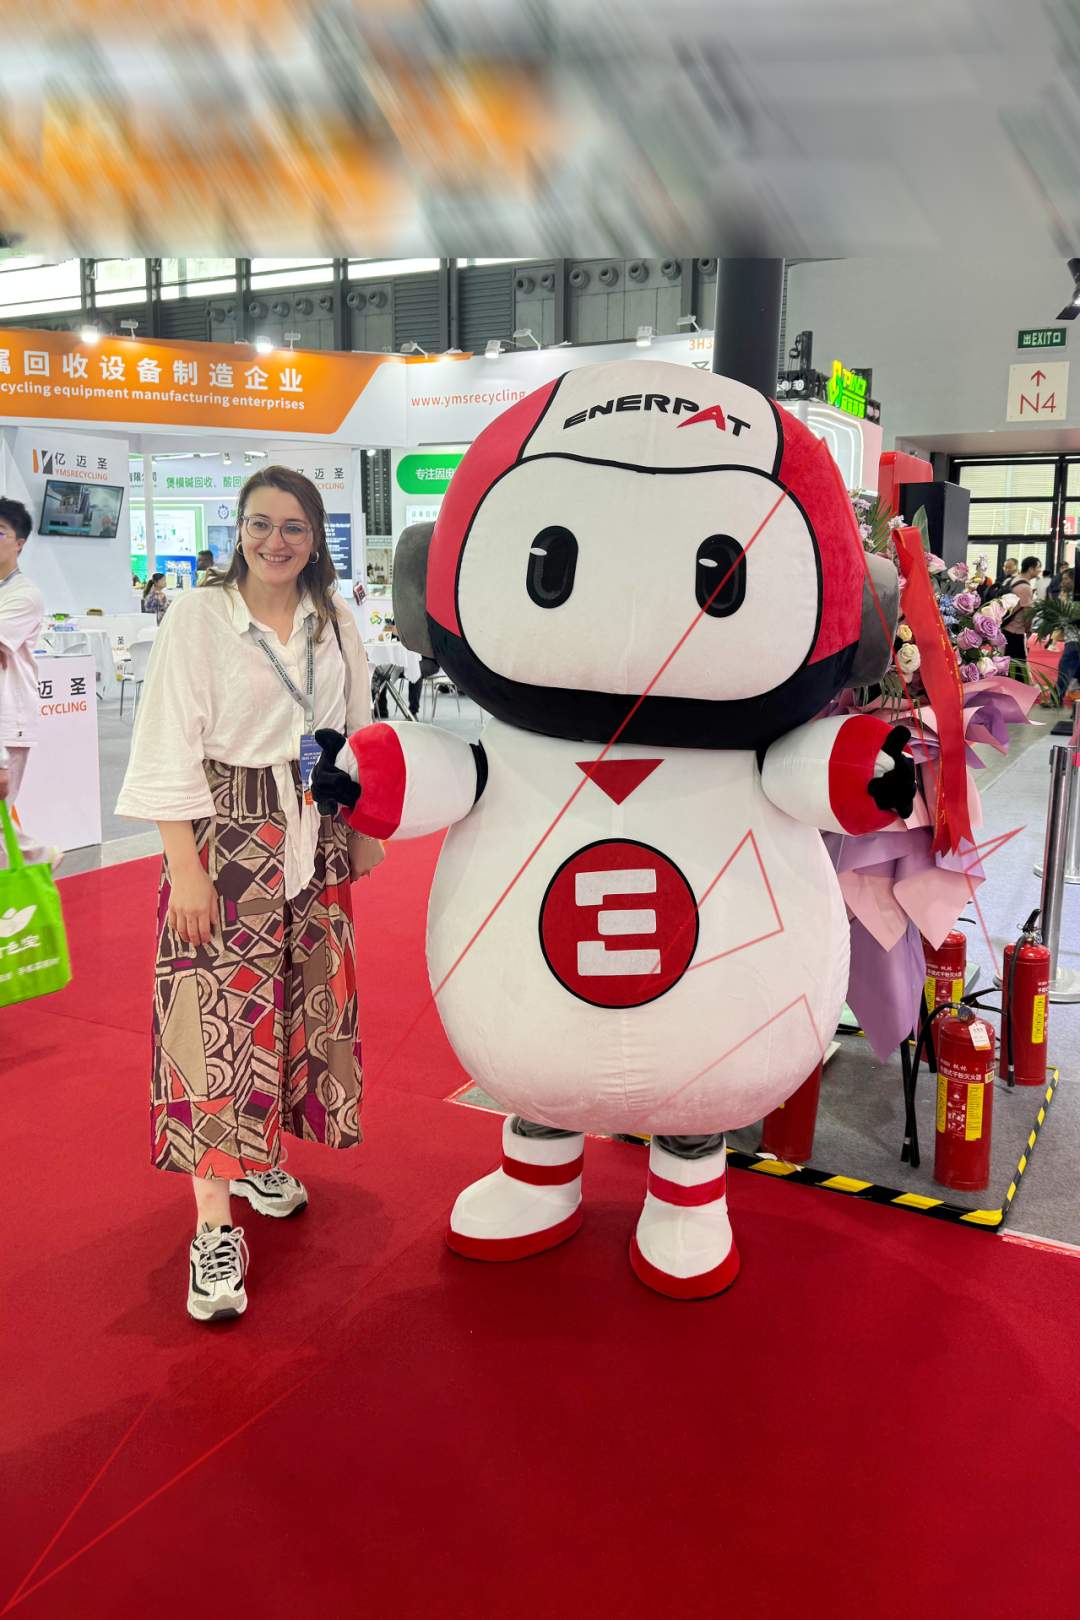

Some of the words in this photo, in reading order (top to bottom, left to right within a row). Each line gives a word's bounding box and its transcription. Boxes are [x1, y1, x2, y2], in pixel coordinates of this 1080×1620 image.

[1, 381, 51, 397] cycling
[54, 385, 129, 399] equipment
[132, 389, 230, 407] manufacturing
[232, 396, 305, 410] enterprises
[1019, 391, 1057, 414] N4
[563, 394, 751, 437] ENERPAT
[55, 452, 108, 470] 亿迈圣
[55, 468, 108, 481] YMSRECYCLING
[39, 700, 87, 717] CYCLING
